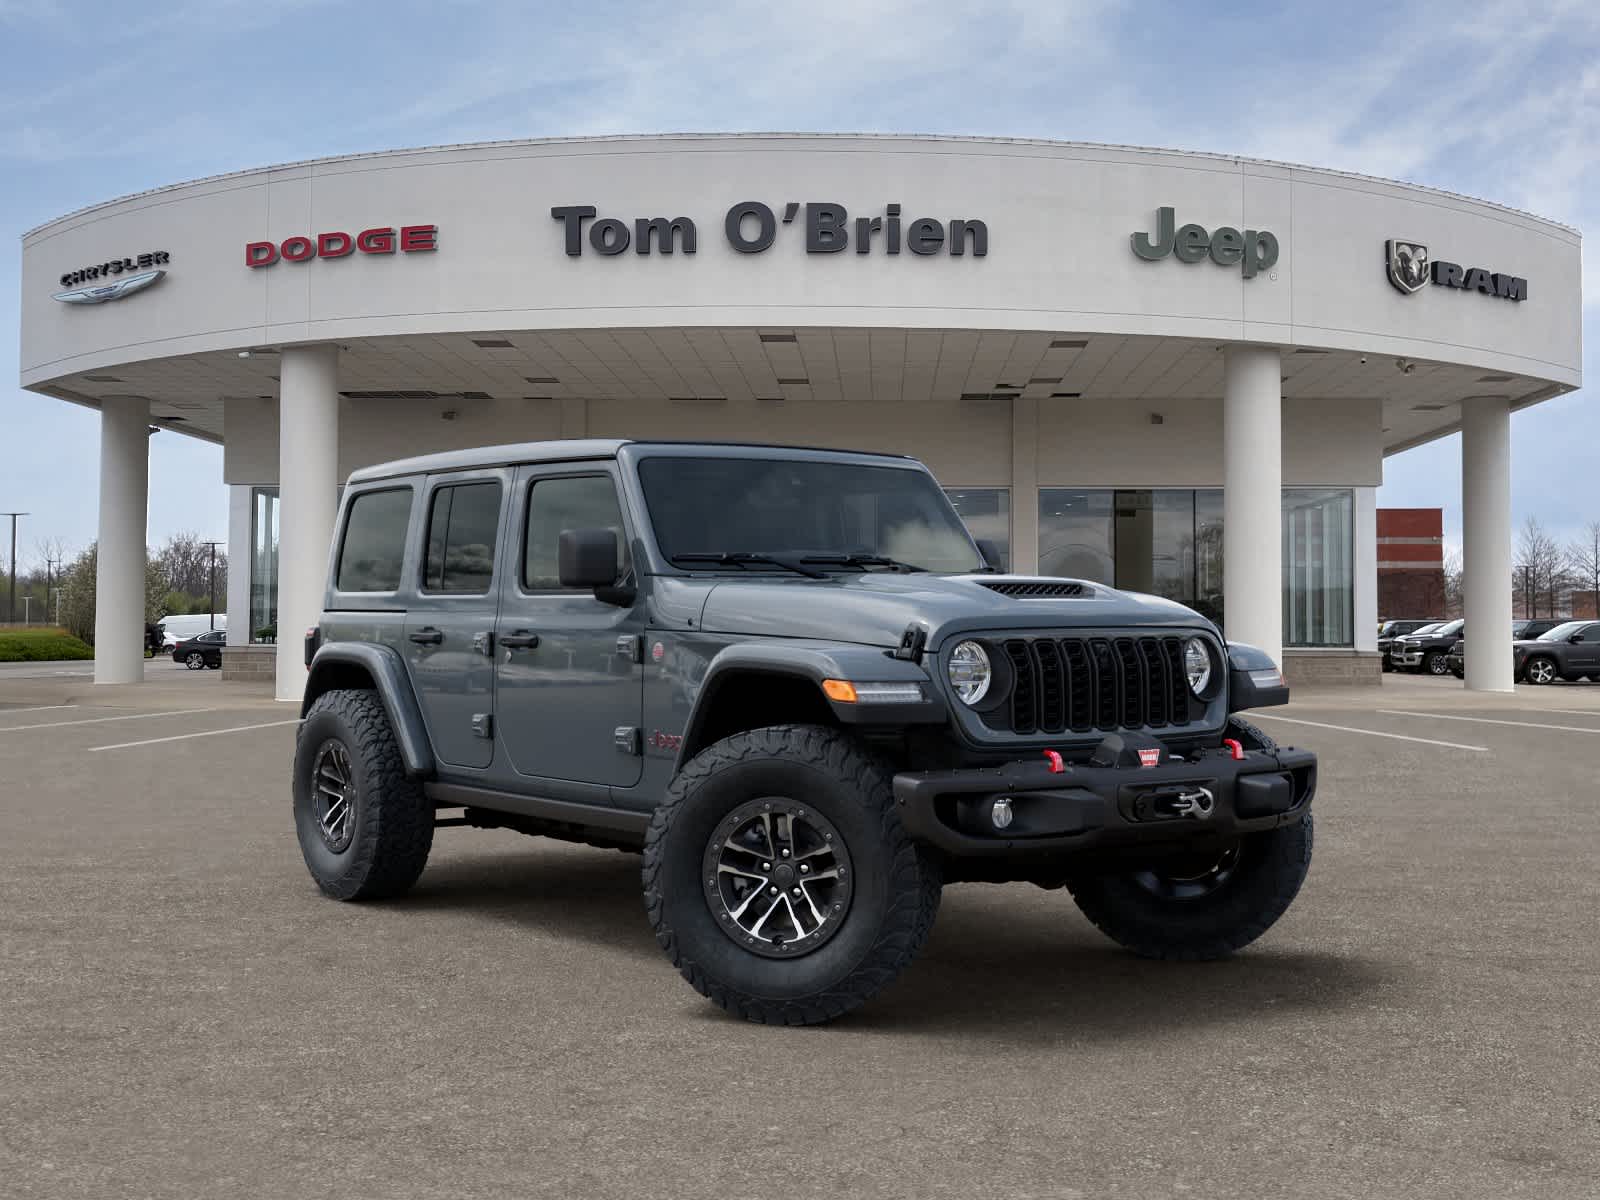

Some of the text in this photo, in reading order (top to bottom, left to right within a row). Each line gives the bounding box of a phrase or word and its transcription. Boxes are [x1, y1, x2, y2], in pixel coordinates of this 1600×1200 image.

[245, 224, 438, 269] DODGE
[551, 201, 989, 257] Tom O'Brien
[1130, 206, 1280, 280] Jeep
[60, 250, 170, 287] CHRYSLER
[1430, 260, 1528, 302] RAM
